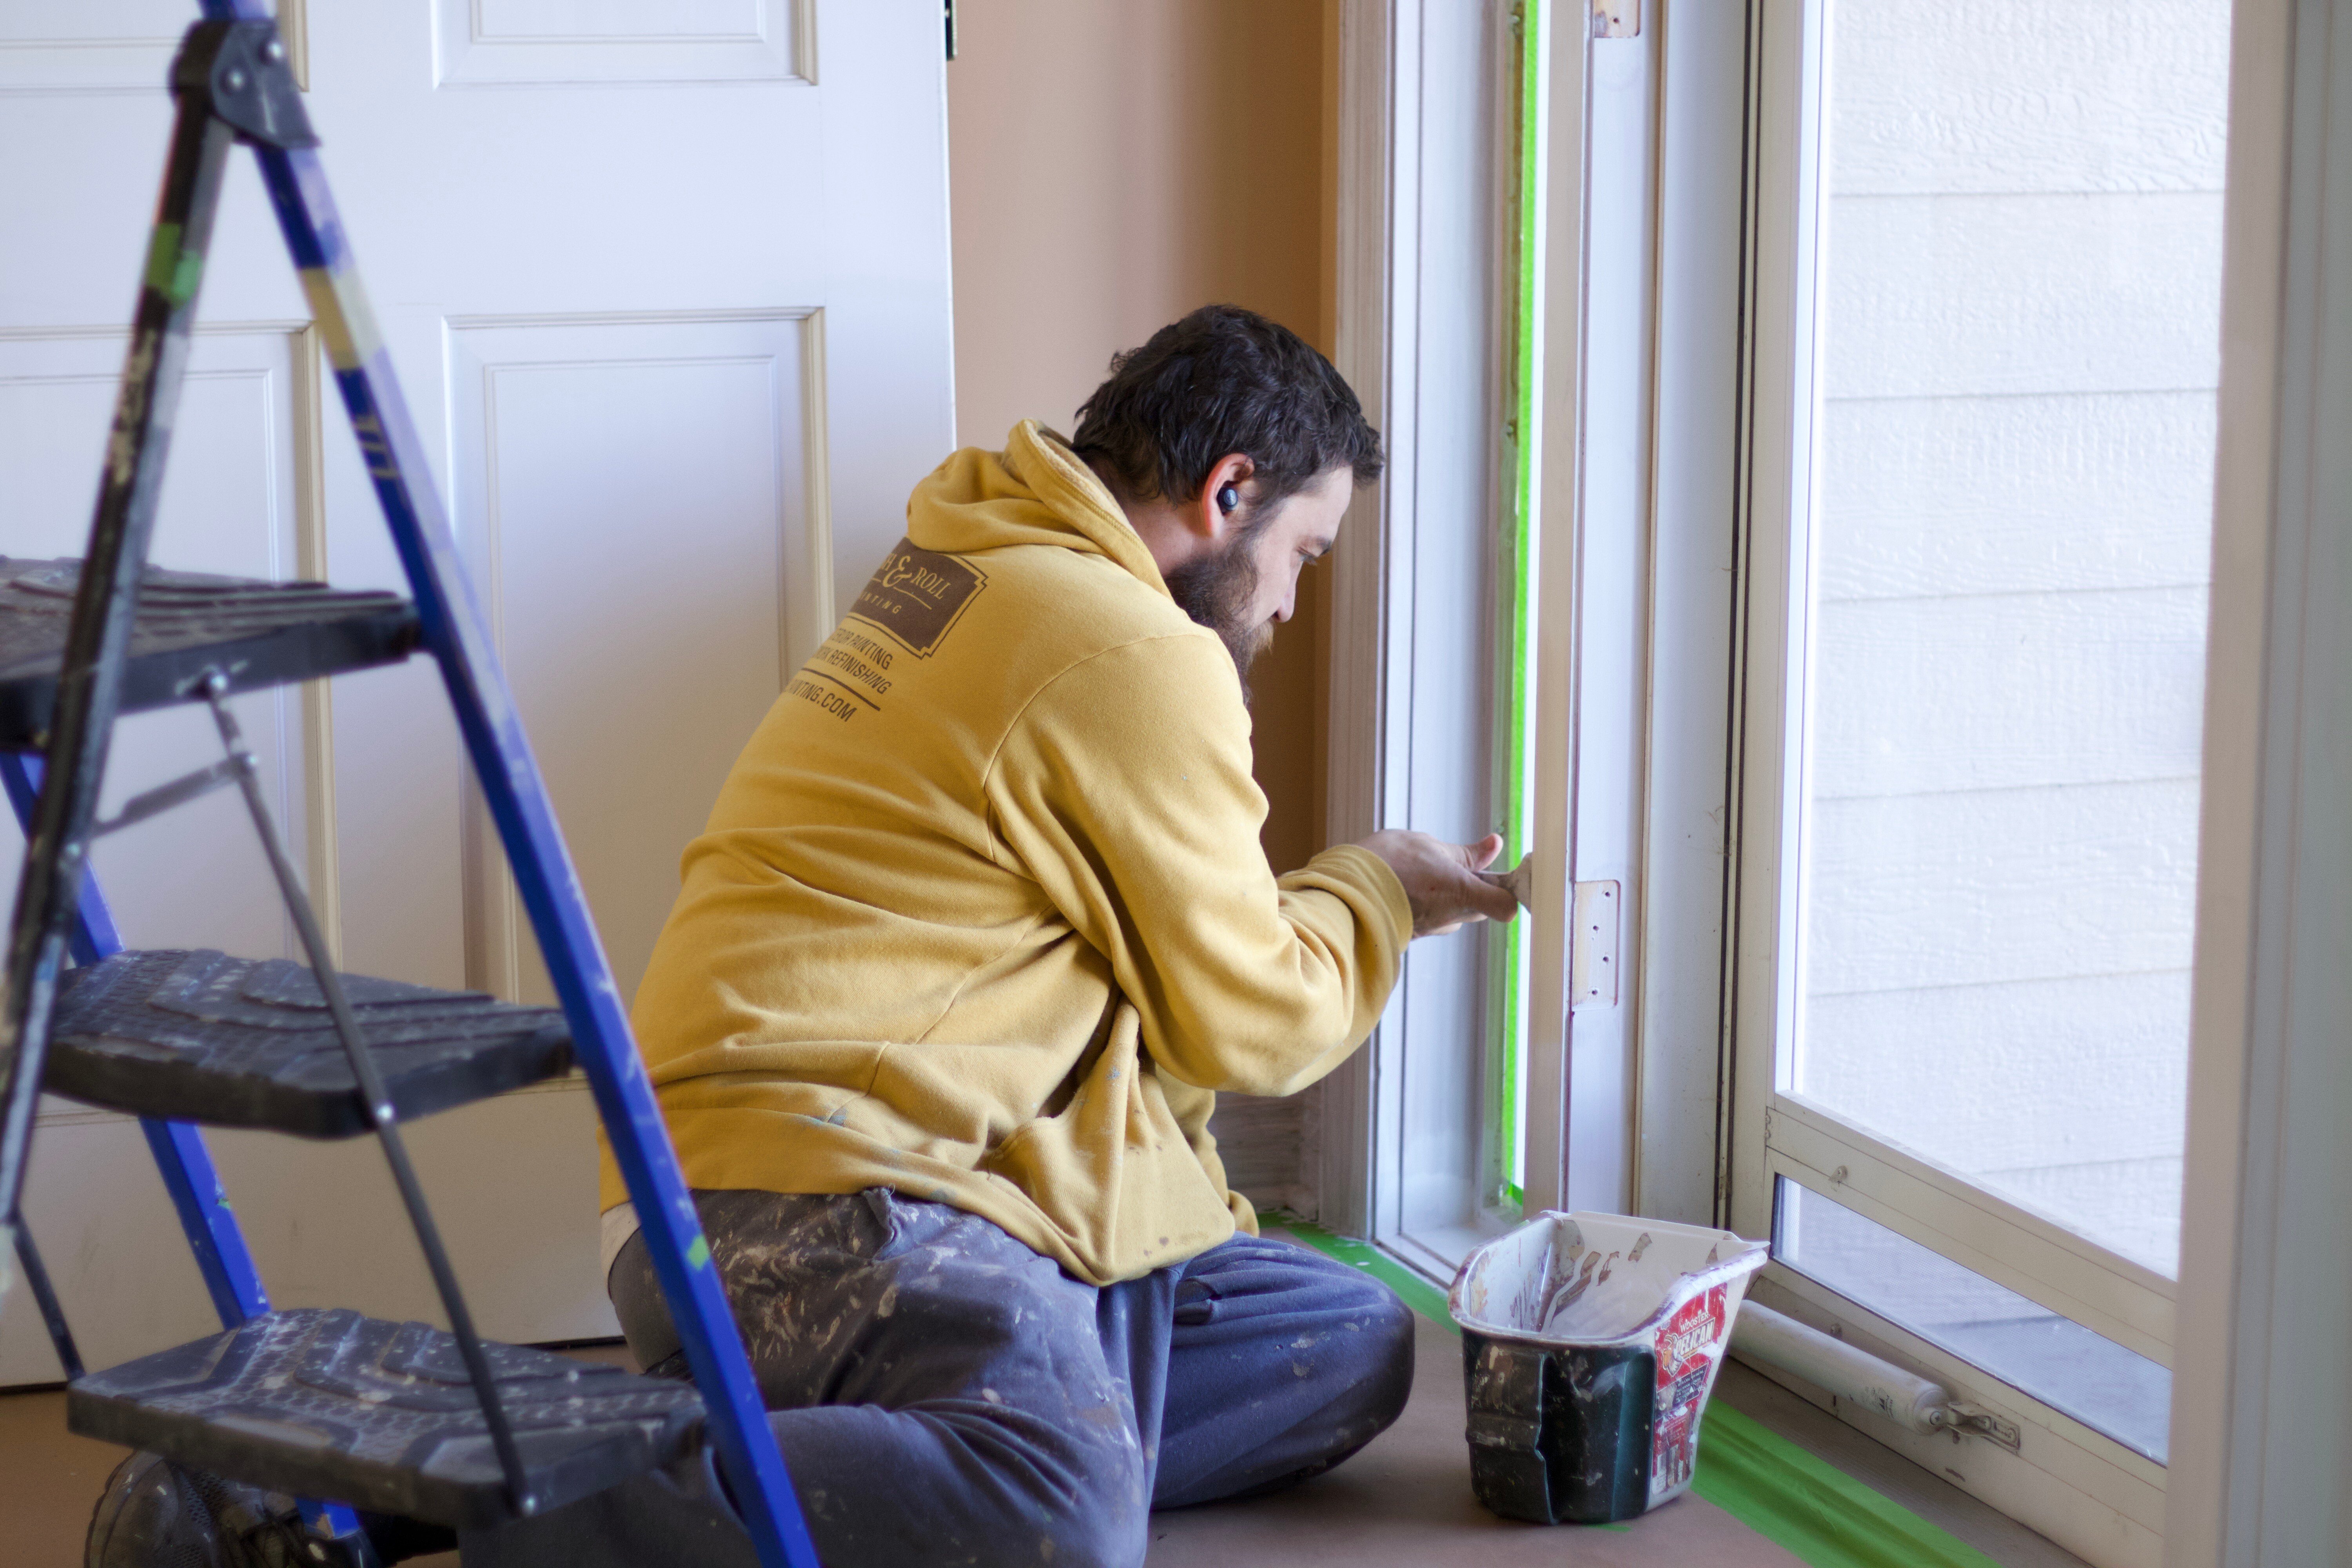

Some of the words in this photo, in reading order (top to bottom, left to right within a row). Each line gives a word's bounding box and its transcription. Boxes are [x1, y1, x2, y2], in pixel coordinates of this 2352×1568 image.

[882, 553, 897, 571] H
[882, 555, 913, 588] &
[910, 567, 951, 600] ROLL
[860, 591, 902, 614] NTING
[828, 627, 855, 646] ERIOR
[849, 634, 893, 670] PAINTING
[826, 649, 892, 694] REFINISHING
[789, 679, 858, 722] NTING.COM
[1680, 1309, 1710, 1333] WOOSTER
[1675, 1321, 1713, 1356] PELICAN
